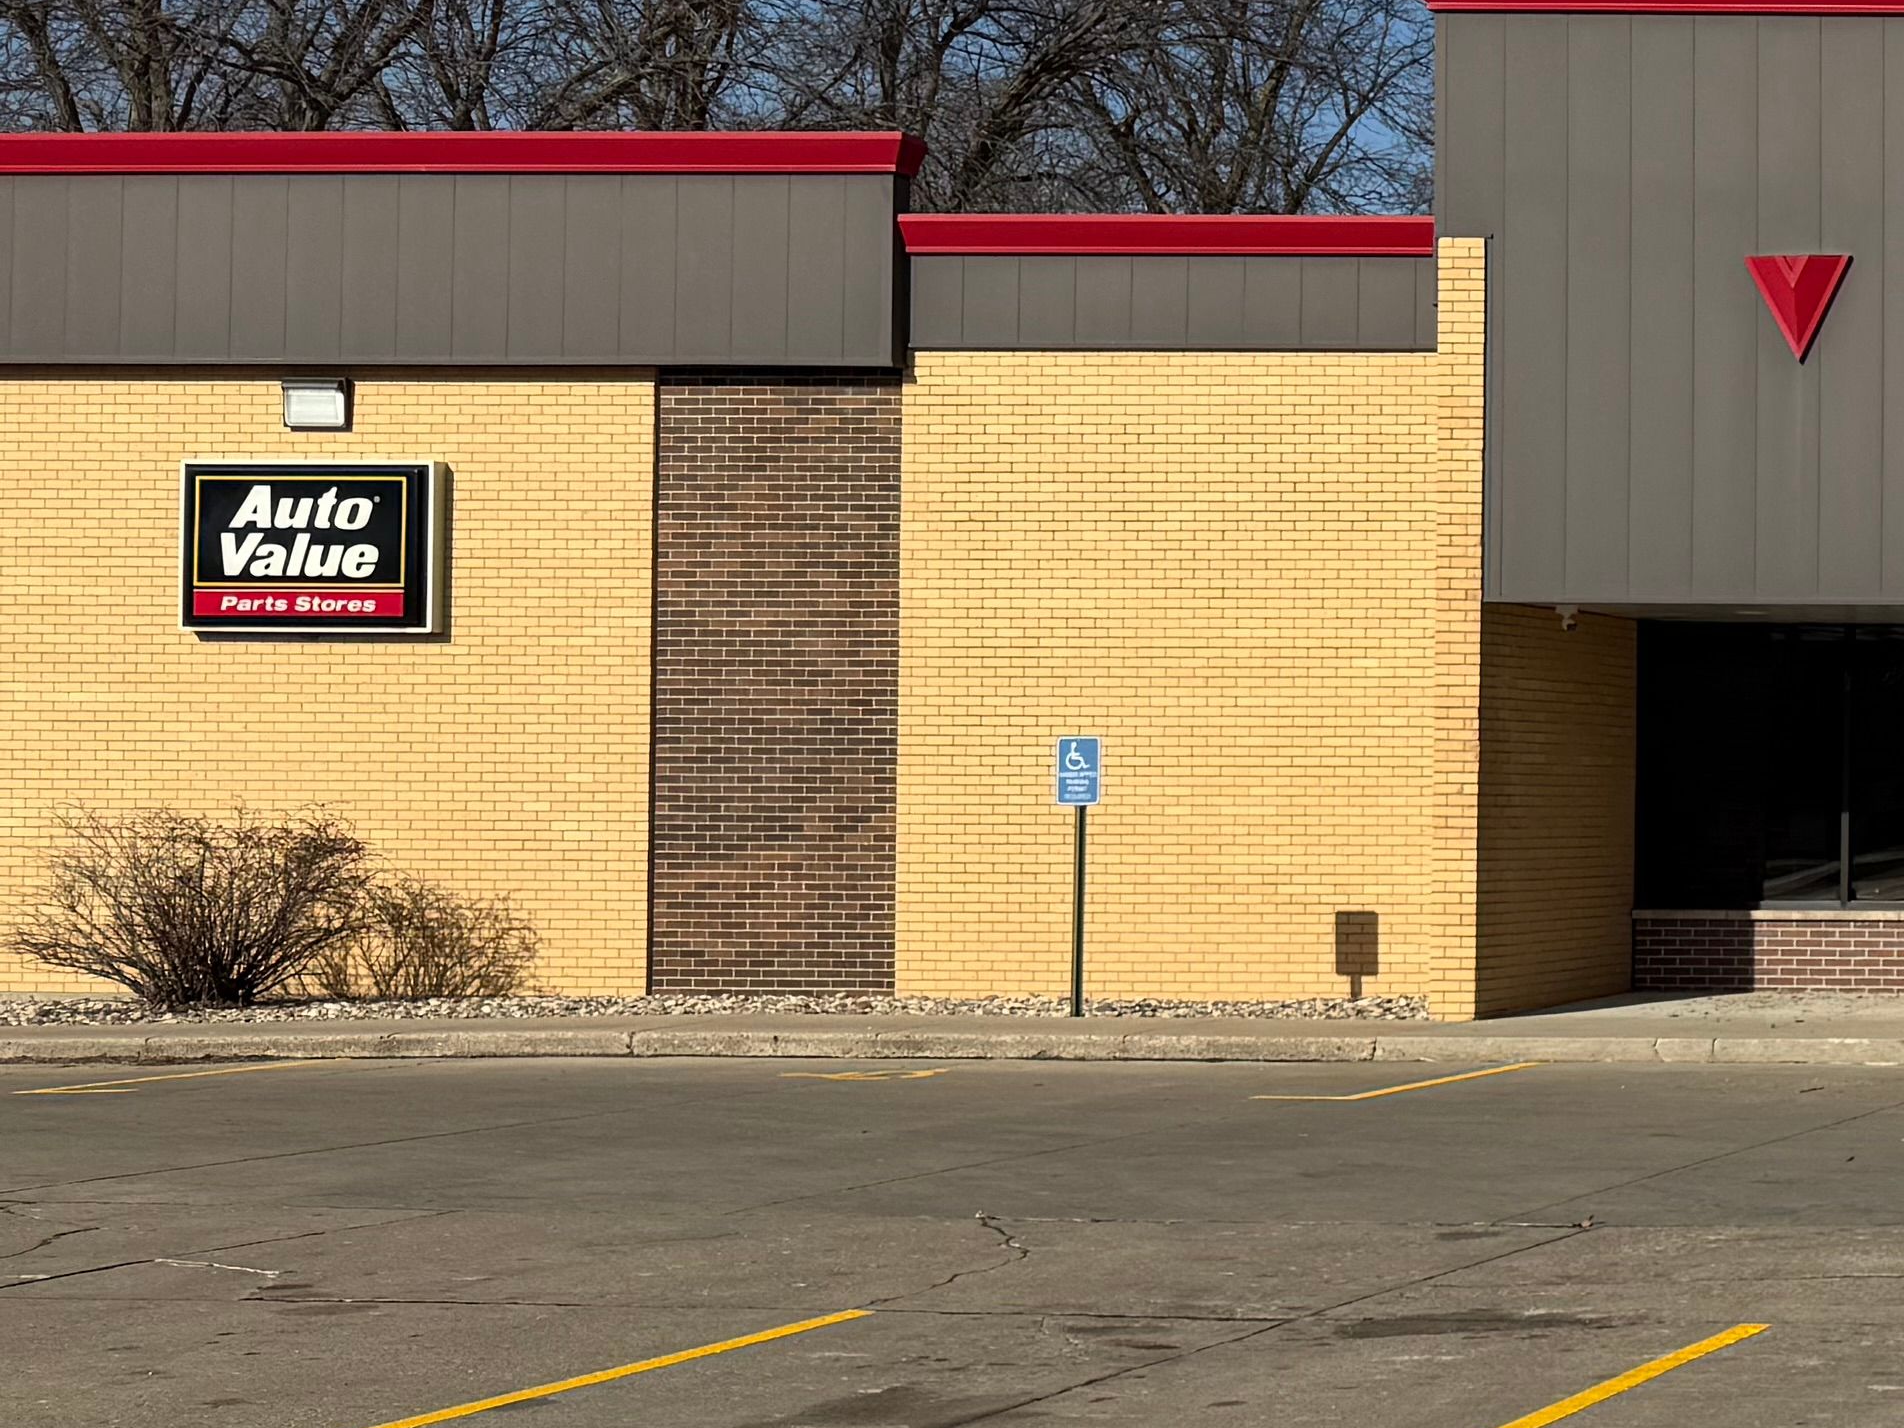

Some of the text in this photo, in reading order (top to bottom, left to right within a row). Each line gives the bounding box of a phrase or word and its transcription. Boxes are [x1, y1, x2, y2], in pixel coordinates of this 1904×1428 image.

[228, 484, 375, 531] Auto
[219, 532, 380, 579] Value
[219, 594, 377, 613] Parts Stores
